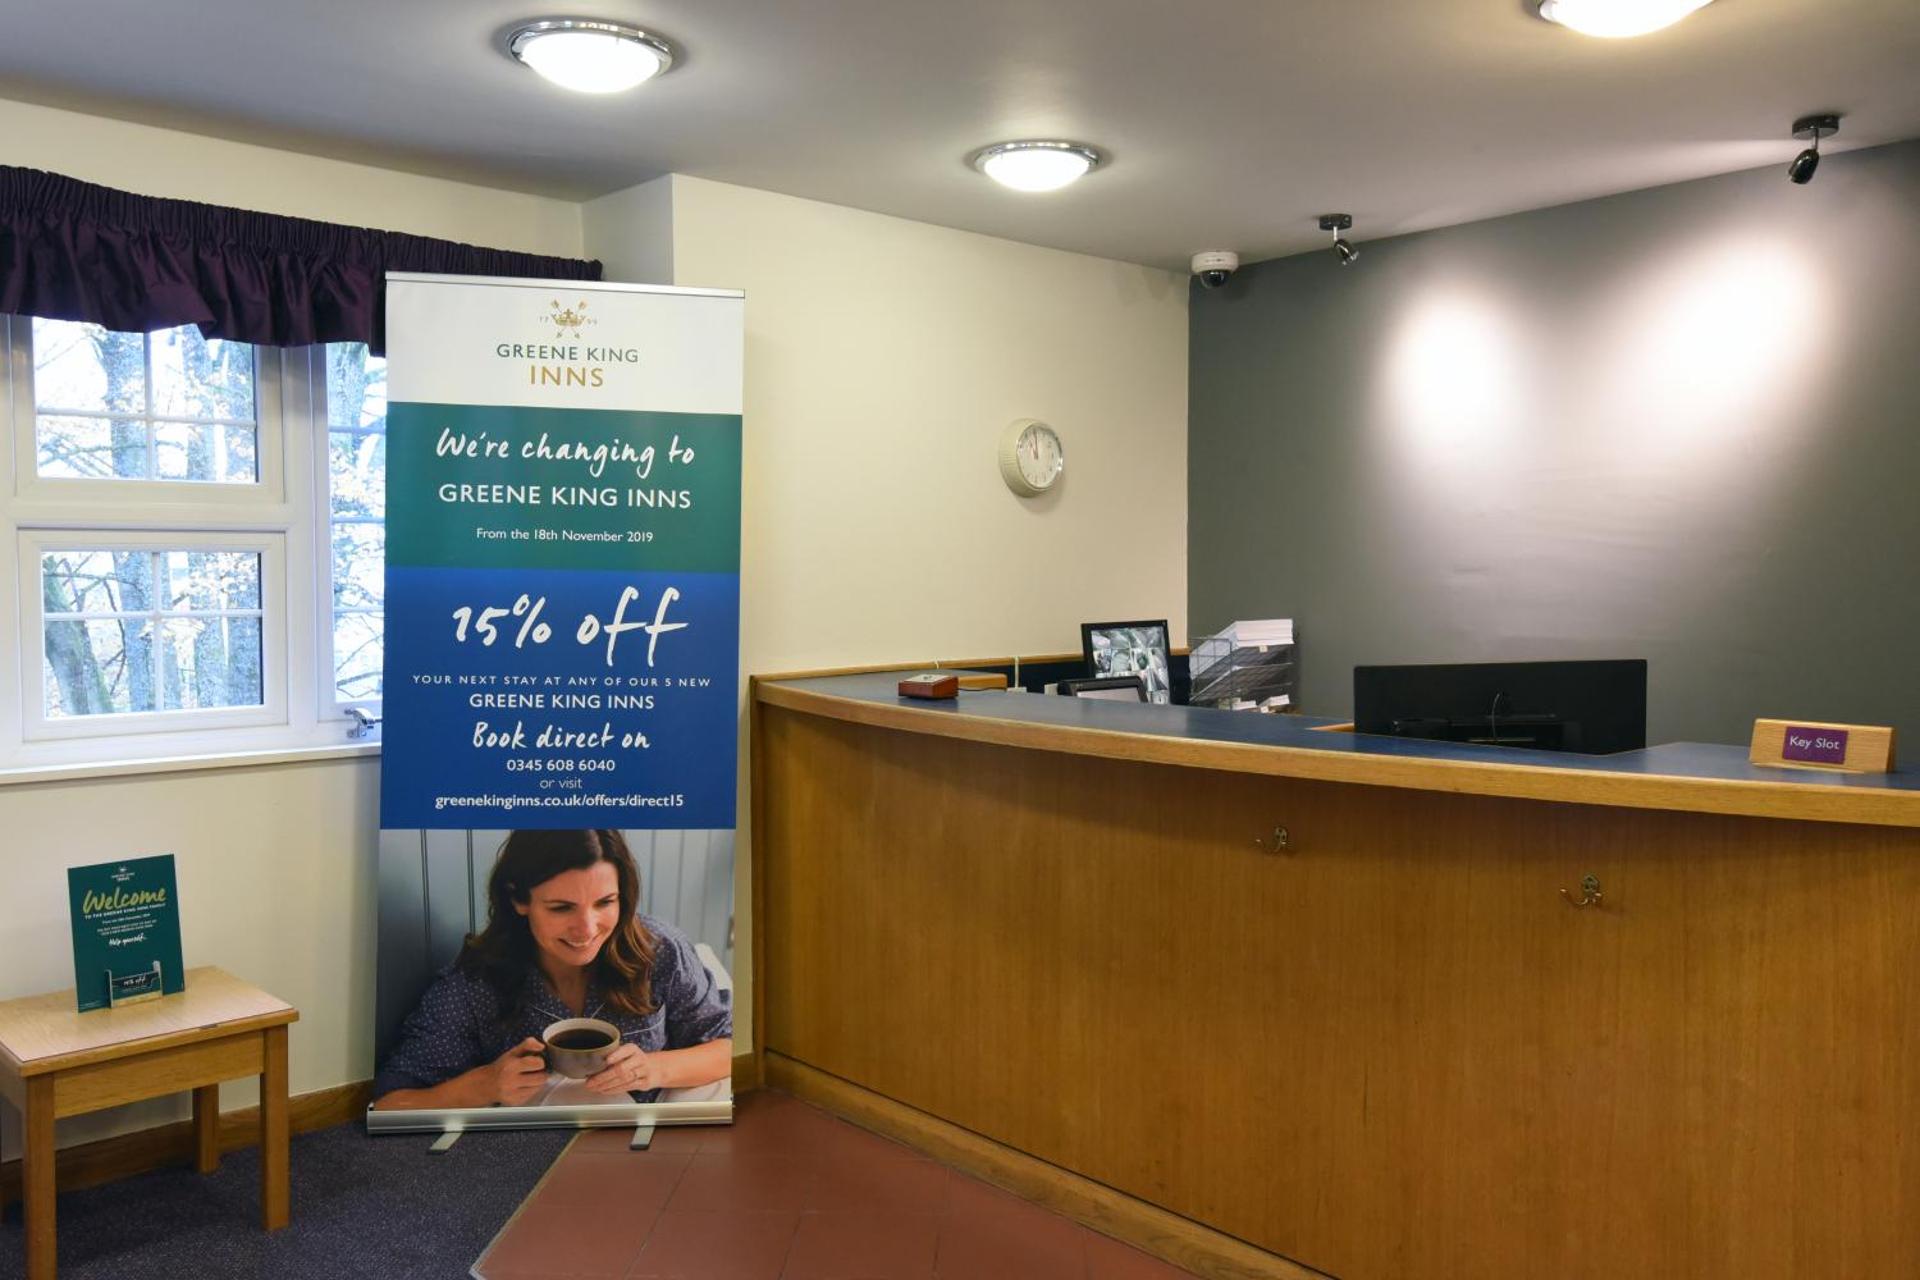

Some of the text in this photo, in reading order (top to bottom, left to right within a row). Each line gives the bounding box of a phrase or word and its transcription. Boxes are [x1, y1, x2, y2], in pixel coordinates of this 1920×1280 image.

[497, 344, 638, 362] GREENE KING
[531, 365, 603, 387] INNS
[437, 428, 694, 479] We're changing to
[439, 484, 690, 508] GREENE KING INNS
[477, 528, 653, 542] From the 18th November 2019
[453, 586, 688, 667] 15% off
[413, 675, 451, 683] YOUR
[460, 676, 496, 684] NEXT
[504, 676, 536, 684] STAY
[545, 677, 560, 685] AT
[569, 677, 596, 685] ANY
[604, 677, 621, 686] OF
[629, 678, 657, 686] OUR
[666, 678, 671, 686] 5
[470, 694, 654, 709] GREENE KING INNS
[473, 721, 649, 749] Book direct on
[1790, 736, 1840, 750] Key Slot
[507, 760, 615, 771] 0345 608 6040
[540, 779, 583, 790] or visit
[436, 794, 684, 810] greenekinginns.co.uk/offers/direct15
[83, 887, 166, 914] Welcome
